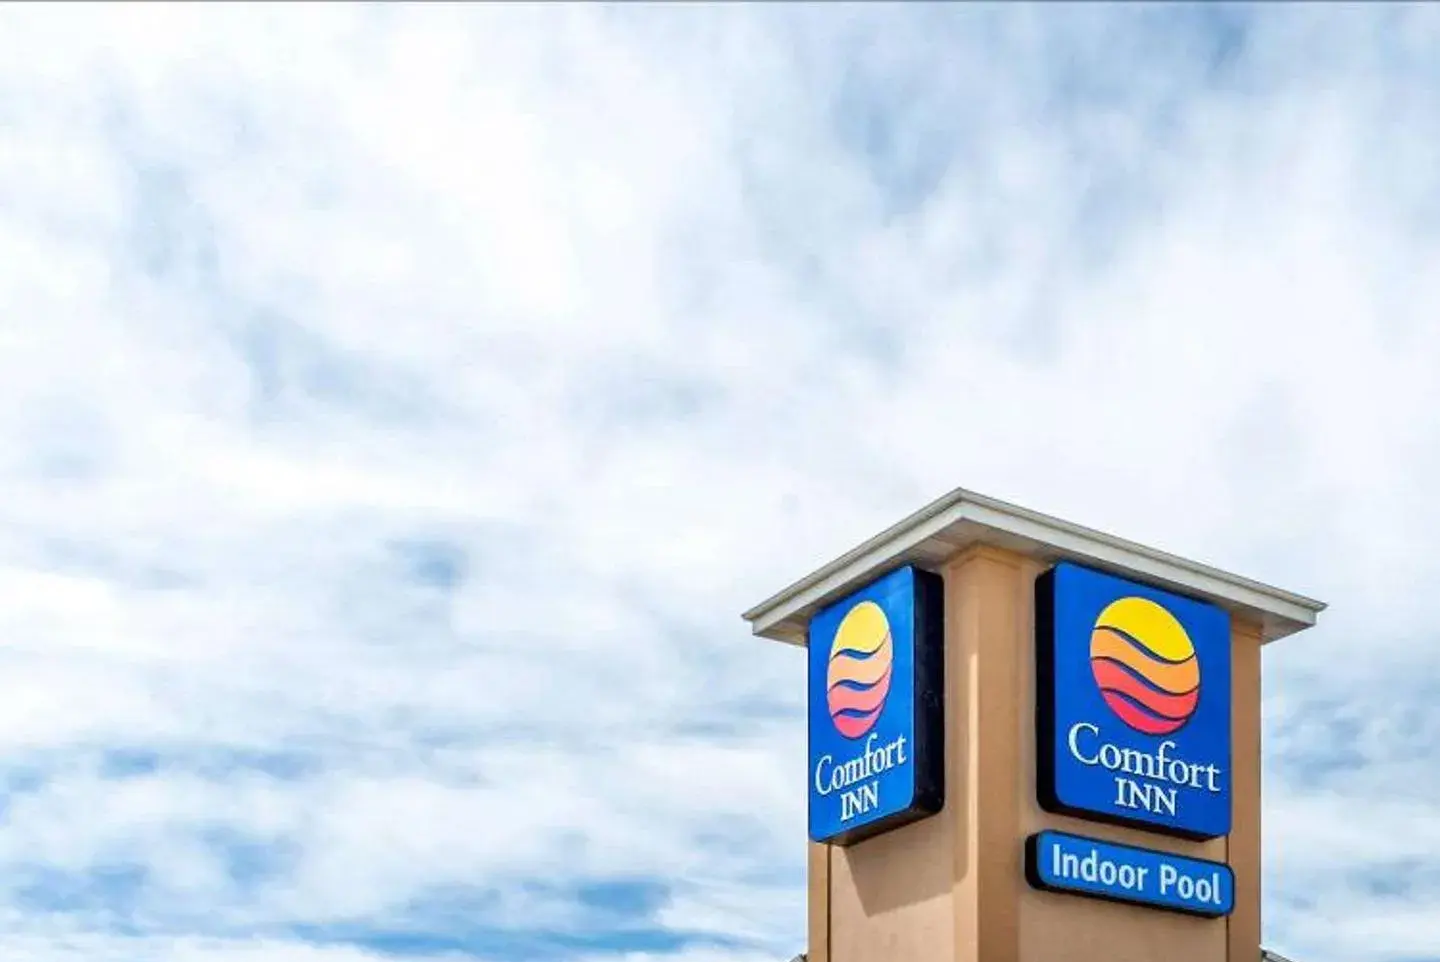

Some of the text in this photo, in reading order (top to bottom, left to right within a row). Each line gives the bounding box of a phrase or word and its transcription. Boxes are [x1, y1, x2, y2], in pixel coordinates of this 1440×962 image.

[815, 732, 906, 796] Comfort
[1068, 722, 1221, 792] Comfort
[840, 781, 879, 821] INN
[1114, 777, 1178, 817] INN
[1052, 844, 1221, 905] Indoor Pool
